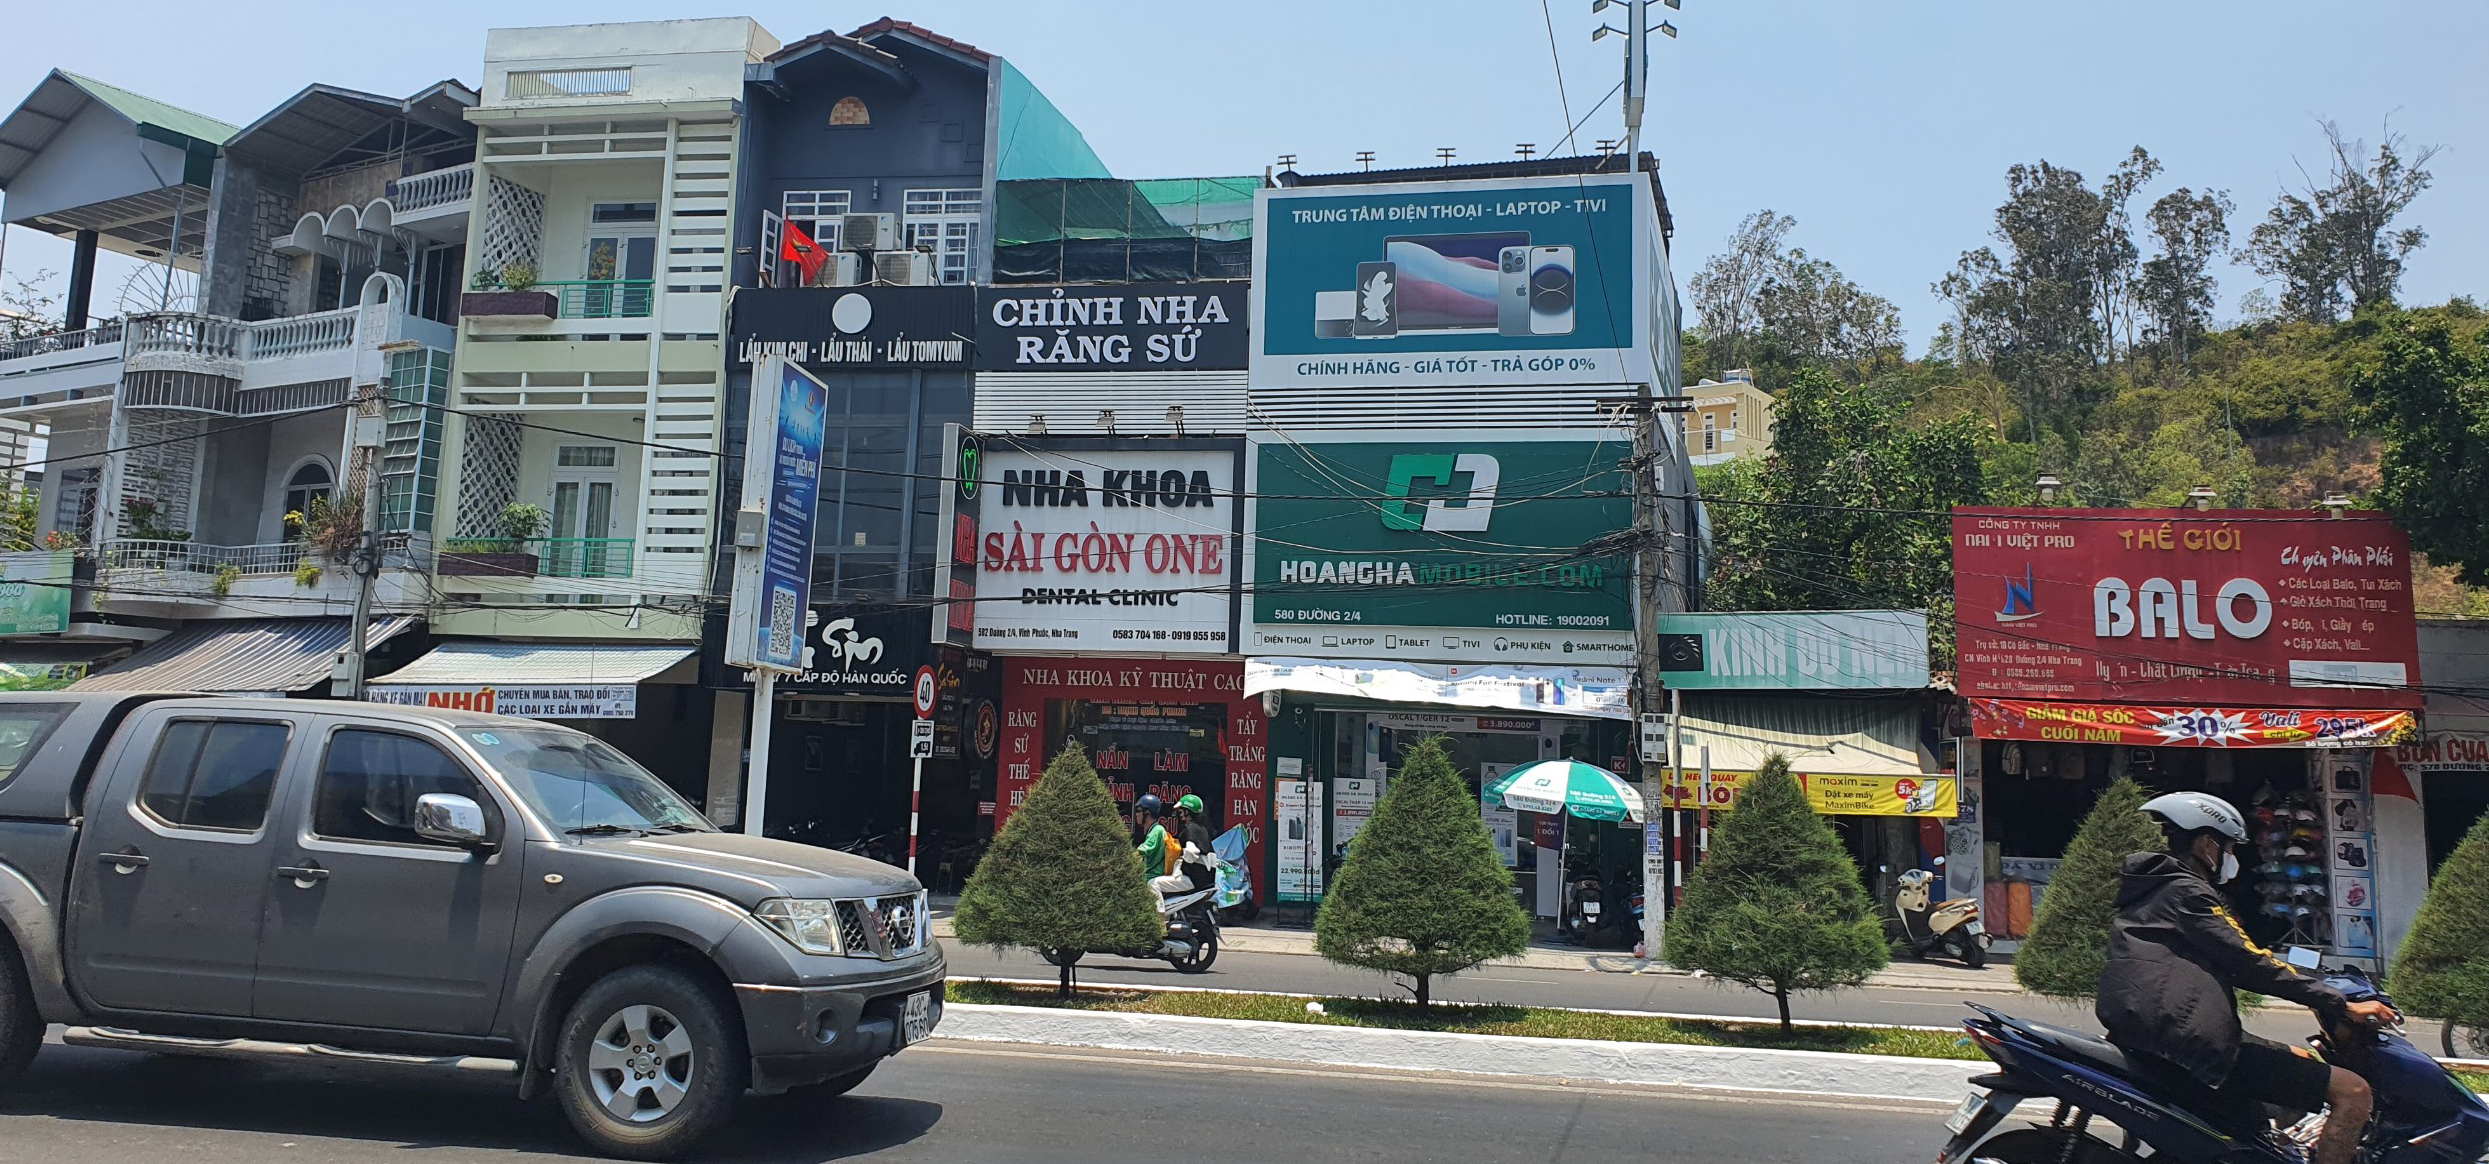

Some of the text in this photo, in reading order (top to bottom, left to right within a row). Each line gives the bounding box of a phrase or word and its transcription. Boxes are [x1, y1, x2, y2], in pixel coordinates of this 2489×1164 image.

[1292, 199, 1606, 223] TRUNG TÂM ĐIỆN THOẠI LAPTOP TIVI
[993, 288, 1229, 327] CHỈNH NHA
[788, 341, 808, 363] CHI
[821, 333, 873, 363] LẨU THÁI
[887, 332, 963, 363] LẨU TOMYUM
[1016, 325, 1203, 364] RĂNG SỨ
[1297, 355, 1596, 375] CHÍNH HÃNG GIÁ TỐT TRẢ GÓP 0%
[1003, 469, 1214, 508] NHA KHOA
[1978, 517, 2060, 530] CÔNG TY TNHH
[2007, 533, 2075, 550] VIỆT PRO
[2184, 521, 2242, 550] GIỚI
[985, 520, 1223, 574] SÀI GÒN ONE
[2289, 578, 2308, 589] Các
[2378, 579, 2401, 591] Xách
[1022, 588, 1178, 607] DENTAL CLINIC
[2358, 597, 2387, 612] Trang
[1274, 608, 1361, 621] 580 ĐƯỜNG 2/4
[2094, 577, 2272, 640] BALO
[1495, 614, 1609, 626] HOTLINE: 19002091
[2291, 618, 2314, 632] Bóp,
[1064, 628, 1078, 640] Trang
[1113, 629, 1226, 641] 0583 704 168 0919 955 958
[1264, 635, 1311, 646] ĐIỆN THOẠI
[1341, 638, 1375, 646] LAPTOP
[1399, 638, 1430, 647] TABLET
[1463, 640, 1480, 648] TIVI
[1510, 640, 1551, 651] PHỤ KIỆN
[1576, 643, 1634, 651] SMARTHOME
[1709, 628, 1787, 676] KINH
[1965, 653, 1974, 663] CN
[2063, 656, 2082, 666] Trang
[794, 668, 818, 684] CẤP
[821, 669, 839, 686] ĐỘ
[842, 670, 868, 684] HÀN
[871, 667, 907, 685] QUỐC
[1023, 667, 1206, 692] NHA KHOA KỸ THUẬT
[428, 687, 495, 714] NHỚ
[533, 690, 550, 700] MUA
[553, 688, 572, 701] BÁN,
[574, 690, 594, 700] TRAO
[919, 681, 931, 704] 40
[520, 704, 541, 717] LOẠI
[544, 705, 555, 714] XE
[581, 703, 601, 714] MÁY
[1008, 708, 1036, 727] RĂNG
[2025, 703, 2135, 724] GIẢM GIÁ SỐC
[2259, 711, 2301, 727] Vali
[1237, 711, 1257, 735] TẨY
[2176, 715, 2236, 737] 30%
[1015, 732, 1029, 753] SỨ
[2041, 724, 2121, 742] CUỐI NĂM
[1154, 748, 1189, 772] LÀM
[1229, 739, 1265, 762] TRẮNG
[1009, 757, 1030, 780] THẾ
[1231, 769, 1261, 789] RĂNG
[1820, 776, 1857, 786] maxim
[1825, 790, 1841, 799] Đặt
[1855, 790, 1873, 801] máy
[1825, 801, 1875, 809] MaximBike
[1234, 795, 1257, 816] HÀN
